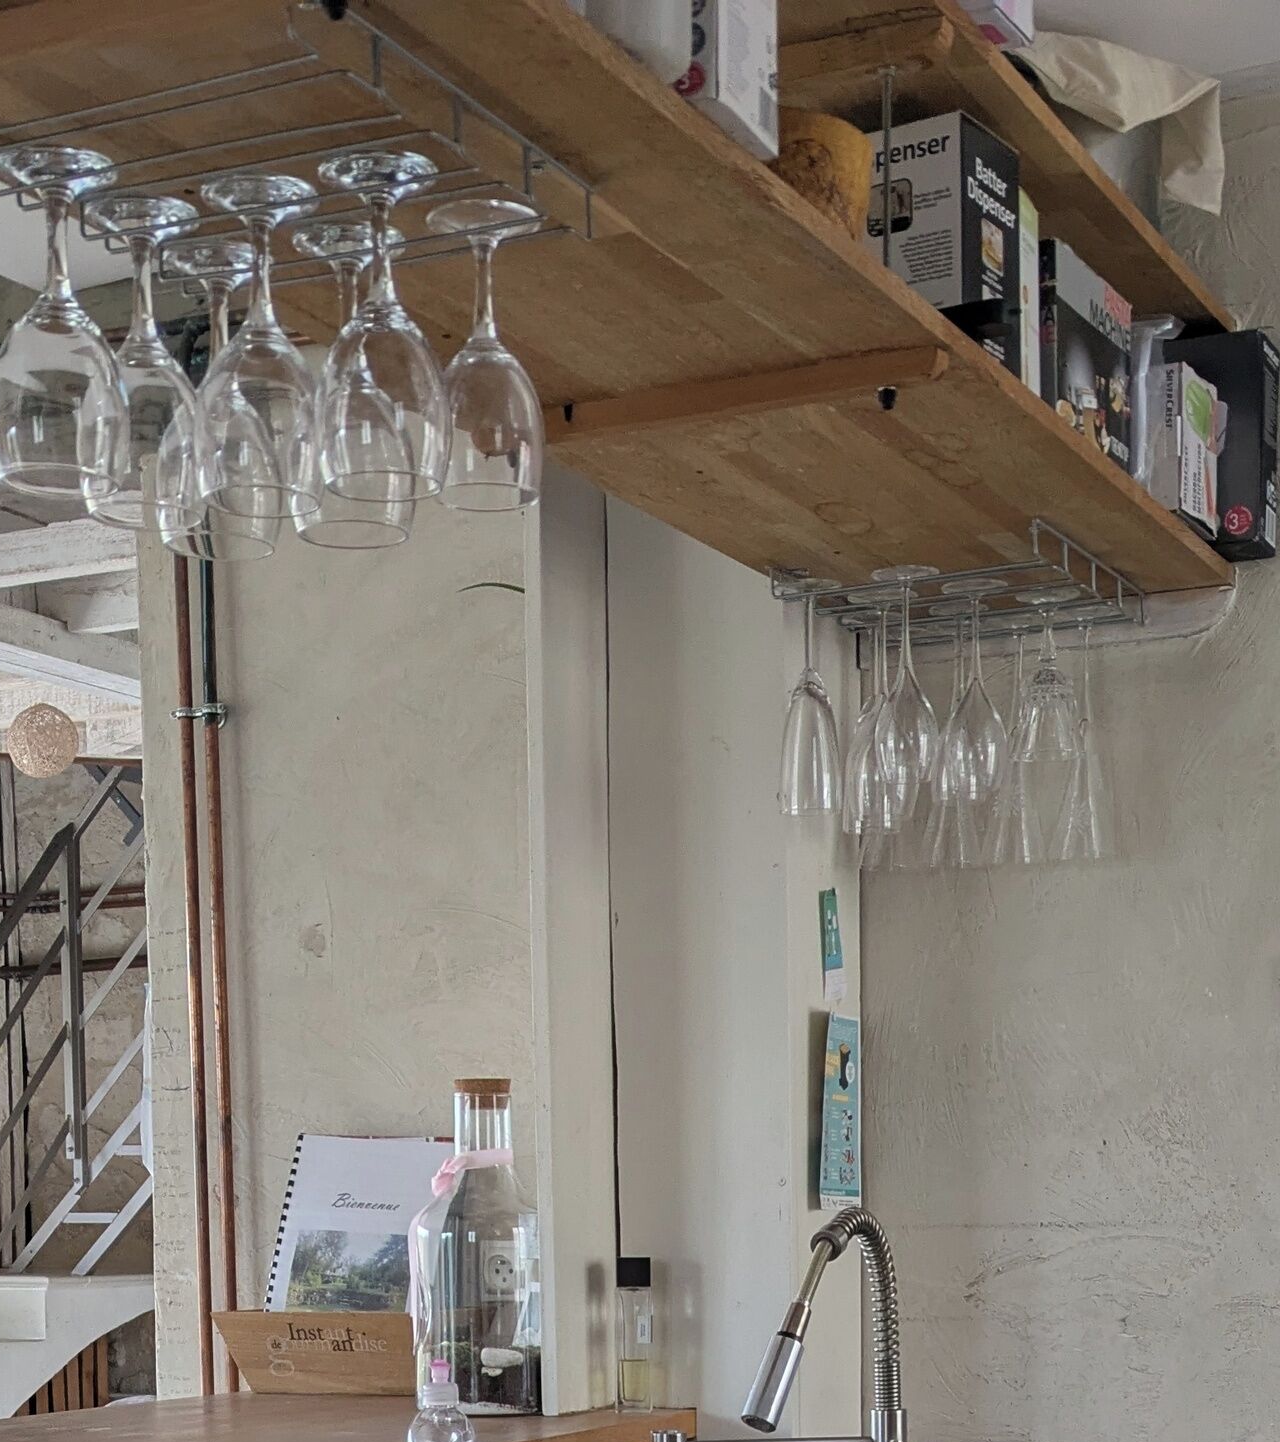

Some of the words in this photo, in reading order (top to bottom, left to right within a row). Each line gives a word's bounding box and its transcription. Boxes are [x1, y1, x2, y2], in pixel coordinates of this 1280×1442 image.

[873, 135, 951, 173] penser
[975, 156, 1008, 198] Batter
[967, 175, 1016, 229] Dispenser
[1089, 298, 1131, 351] MACHINE
[1228, 513, 1239, 530] 3
[331, 1192, 401, 1212] Bienvenue
[287, 1321, 355, 1341] Instant
